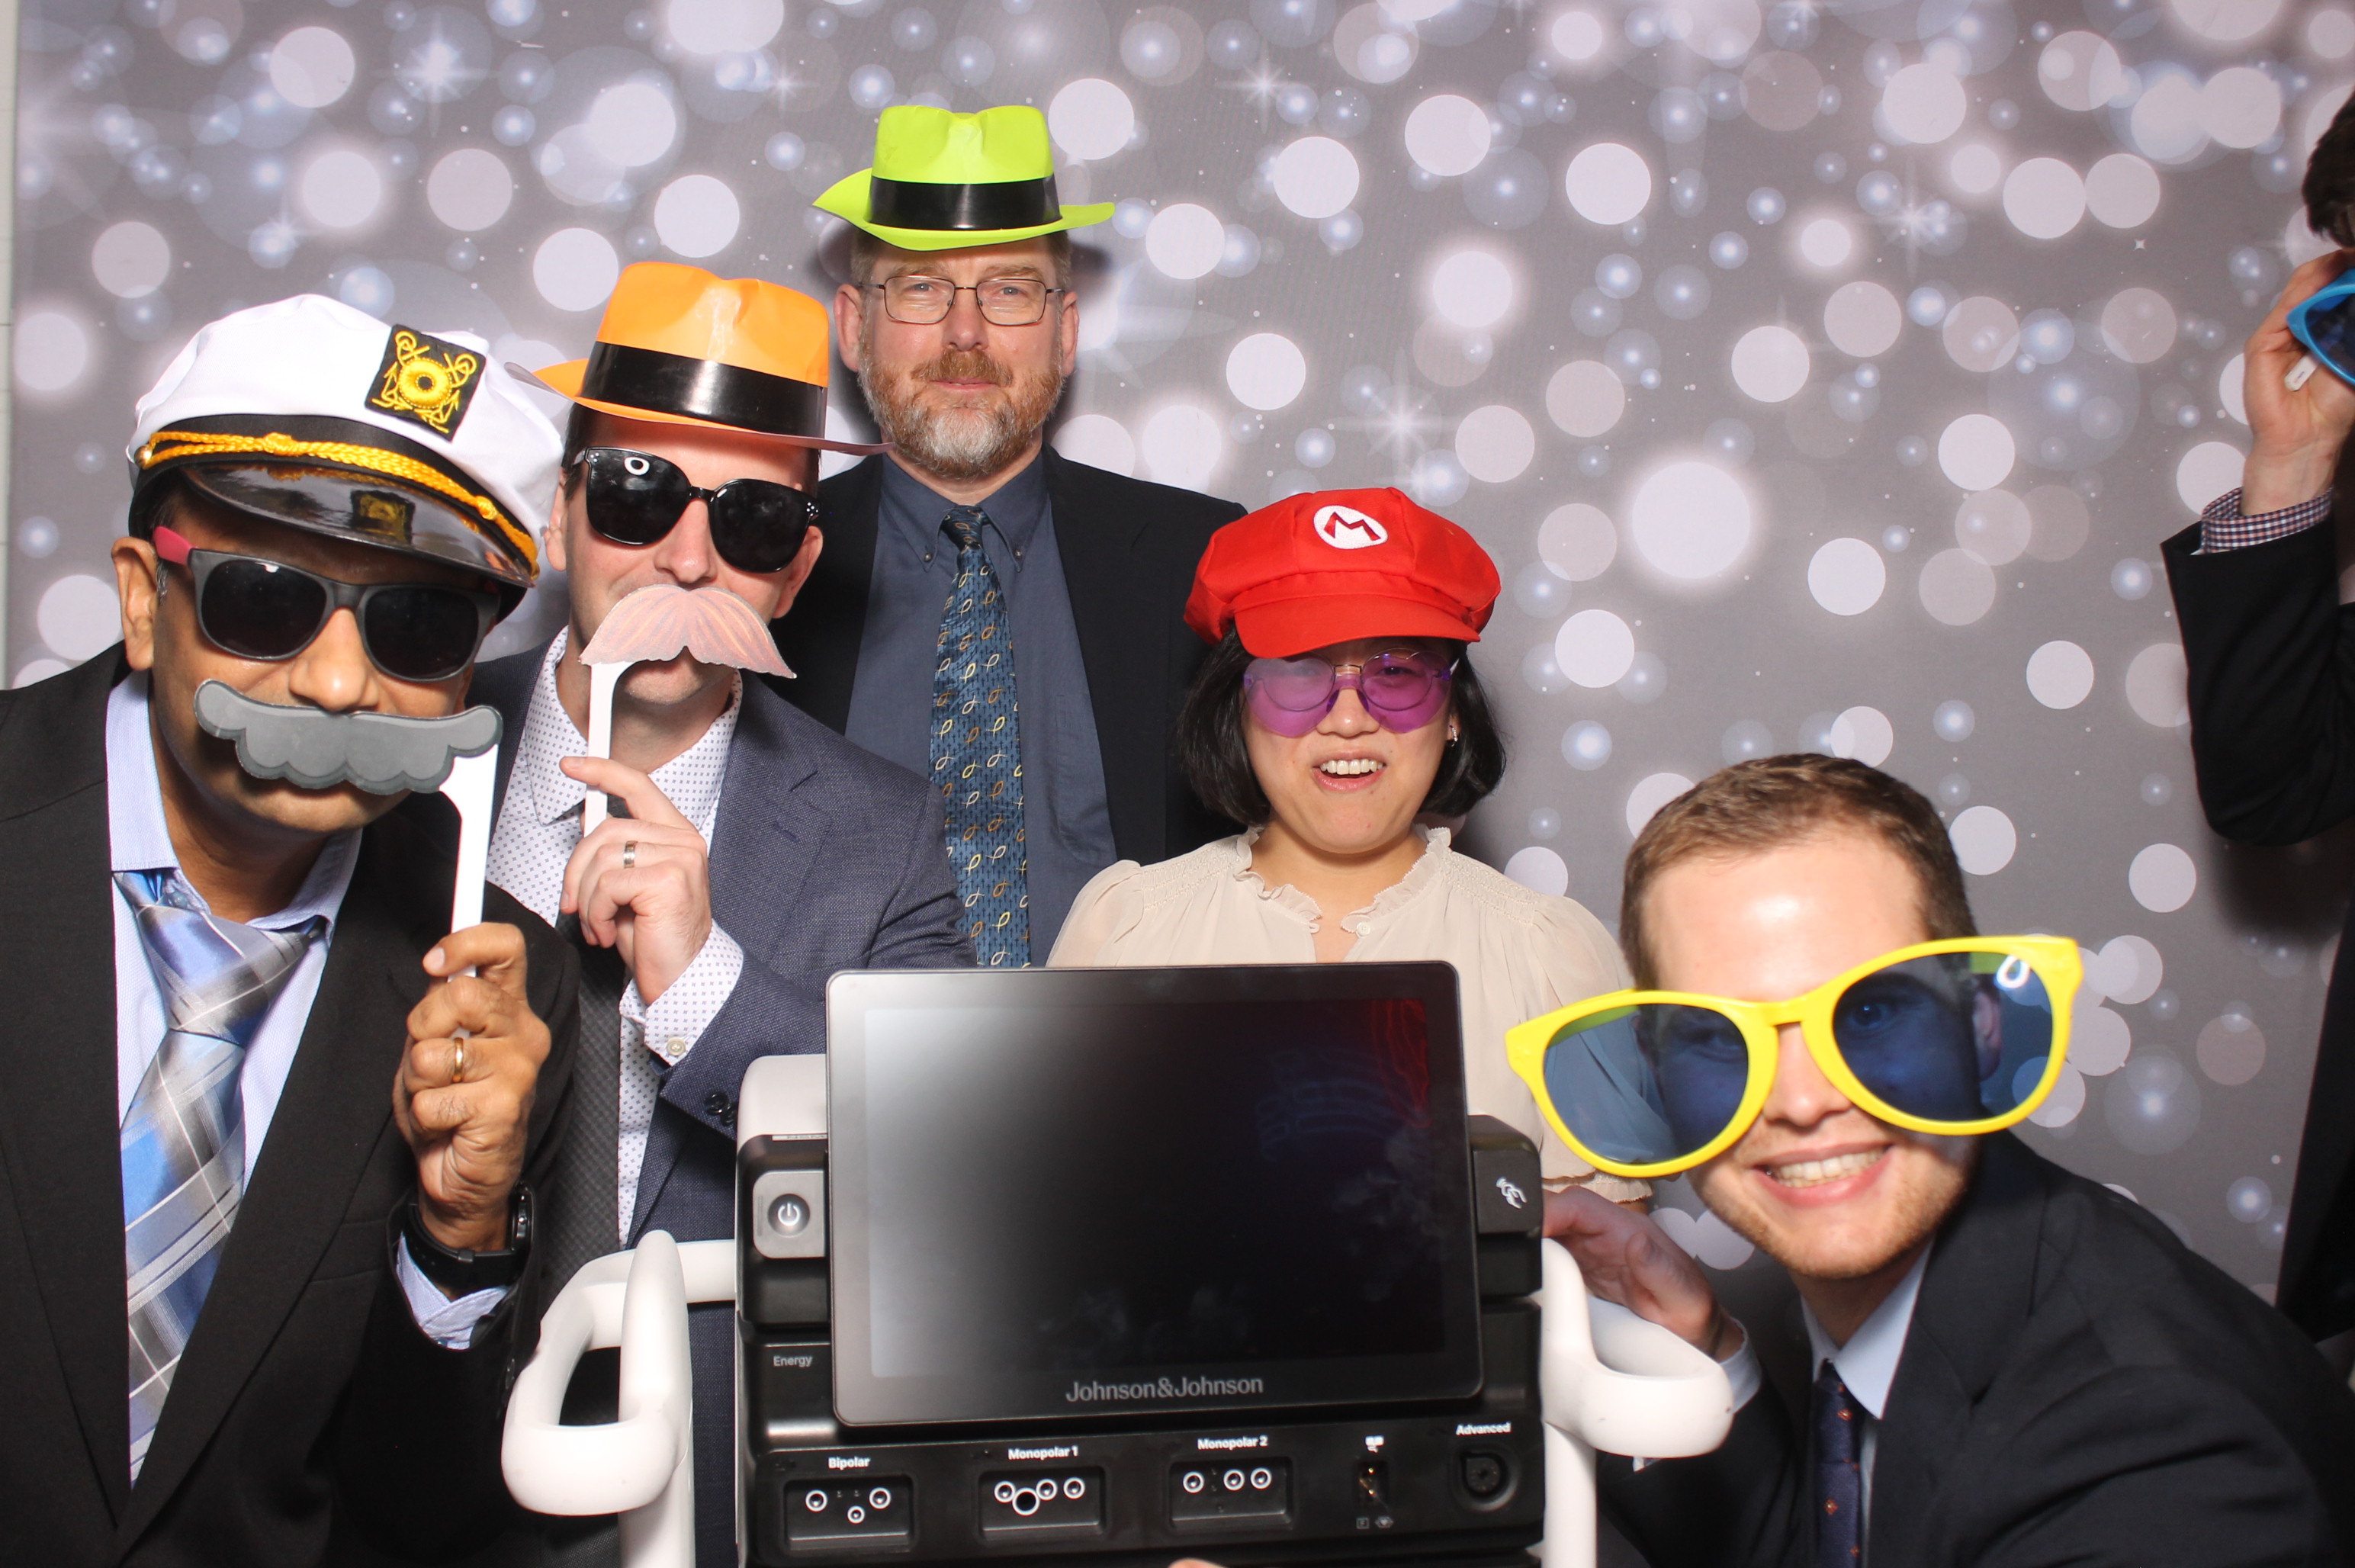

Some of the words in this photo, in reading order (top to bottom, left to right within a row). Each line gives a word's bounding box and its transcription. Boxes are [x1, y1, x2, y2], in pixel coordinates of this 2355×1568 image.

[1323, 511, 1381, 541] M
[773, 1355, 813, 1367] Energy
[1066, 1376, 1264, 1402] Johnson&Johnson
[1455, 1422, 1512, 1435] Advanced
[1197, 1435, 1258, 1451] Monopolar
[1258, 1435, 1268, 1447] 2
[1007, 1446, 1070, 1460] Monopolar
[1071, 1445, 1079, 1457] 1
[827, 1456, 871, 1470] Bipolar
